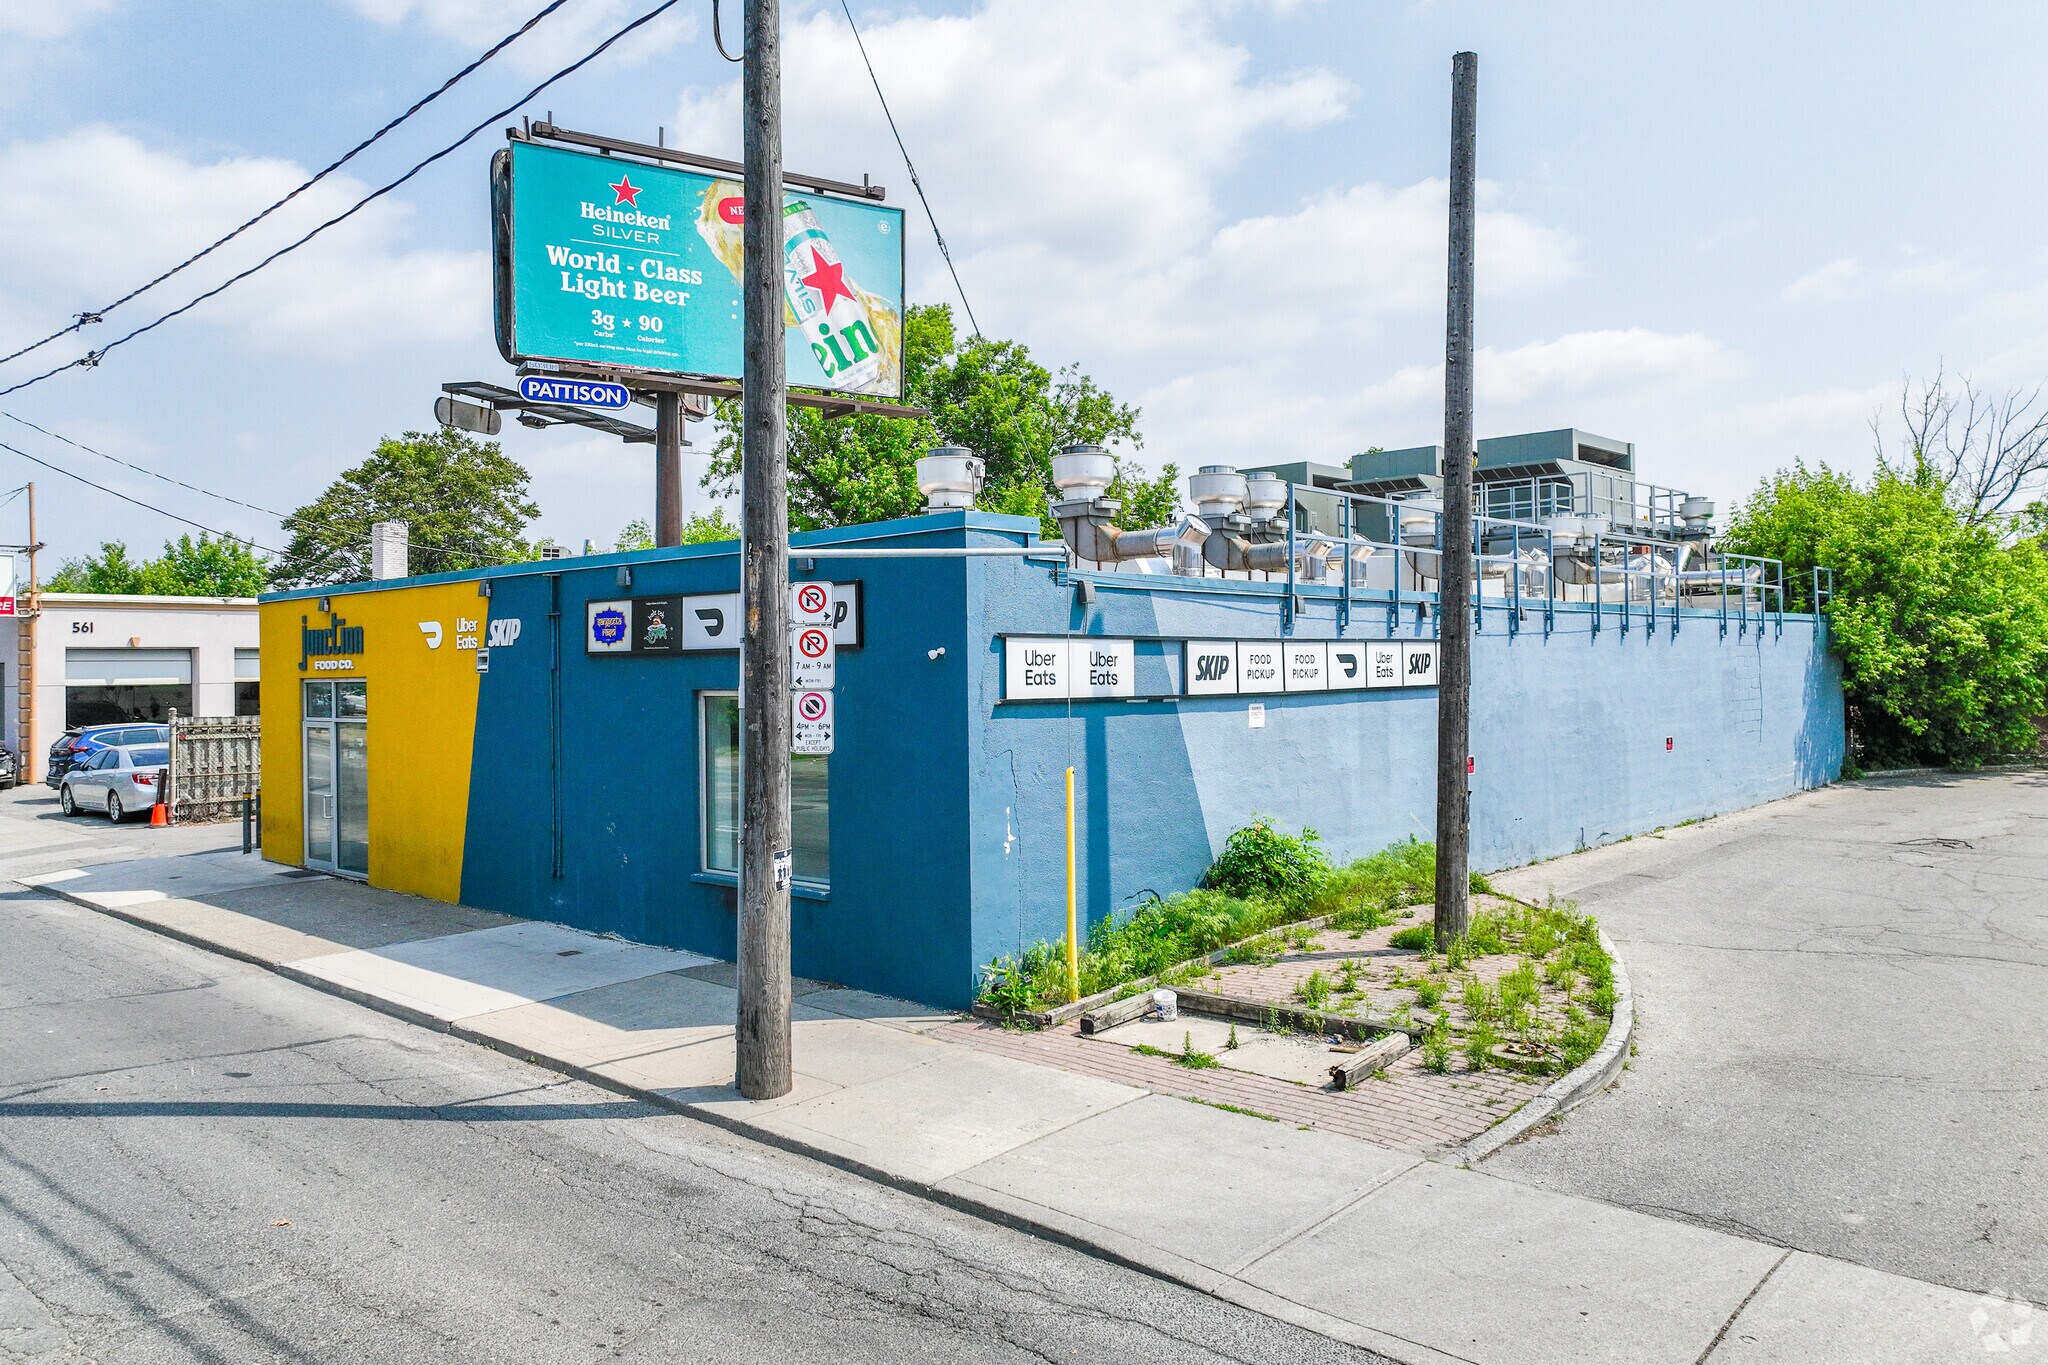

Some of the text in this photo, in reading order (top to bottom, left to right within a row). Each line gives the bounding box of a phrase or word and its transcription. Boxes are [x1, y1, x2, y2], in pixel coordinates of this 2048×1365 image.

[730, 206, 744, 216] NE
[592, 224, 660, 244] SILVER
[545, 245, 621, 275] World
[640, 258, 703, 285] Class
[560, 271, 691, 307] Light Beer
[591, 309, 663, 333] 3g 90
[528, 381, 621, 404] PATTISON
[72, 622, 94, 634] 561
[456, 618, 478, 632] Uber
[488, 618, 522, 647] SKIP
[298, 613, 364, 671] junction
[456, 634, 478, 650] Eats
[314, 660, 354, 670] FOOD CO.
[1025, 650, 1056, 666] Uber
[1090, 651, 1118, 667] Uber
[1250, 654, 1272, 664] FOOD
[1295, 654, 1316, 664] FOOD
[1376, 652, 1392, 663] Uber
[1408, 652, 1431, 674] SKIP
[1196, 655, 1229, 681] SKIP
[1247, 669, 1276, 680] PICKUP
[1292, 669, 1318, 680] PICKUP
[1376, 666, 1394, 678] Eats
[1026, 670, 1056, 686] Eats
[1090, 670, 1118, 685] Eats
